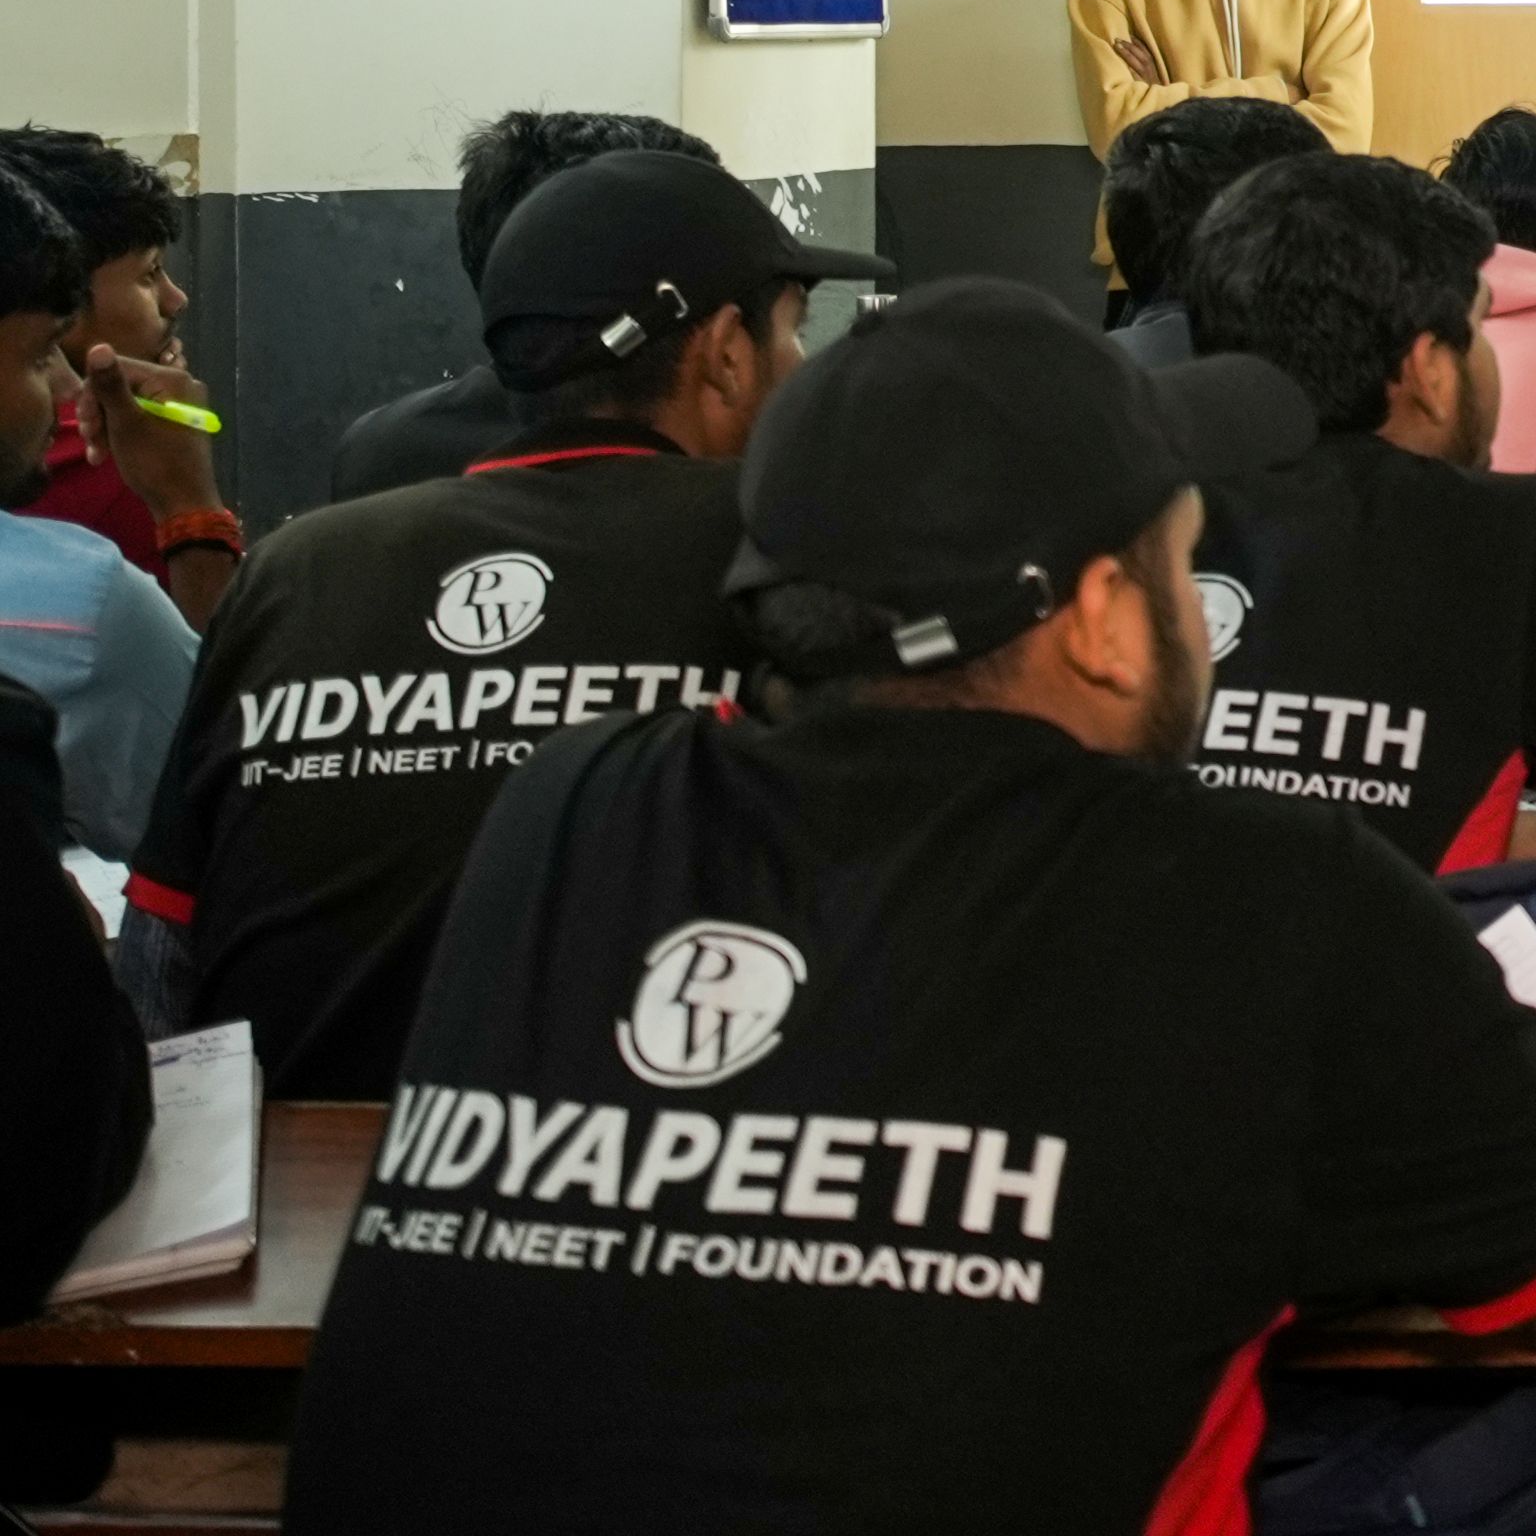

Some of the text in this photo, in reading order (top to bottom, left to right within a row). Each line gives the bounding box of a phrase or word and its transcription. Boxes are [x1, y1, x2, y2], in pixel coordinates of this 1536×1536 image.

[239, 664, 742, 750] VIDYAPEETH
[241, 750, 345, 787] IIT-JEE
[368, 744, 461, 777] NEET
[1187, 762, 1412, 808] OUNDATION
[374, 1082, 1067, 1241] VIDYAPEETH
[494, 1219, 625, 1272] NEET
[658, 1232, 1043, 1304] FOUNDATION
